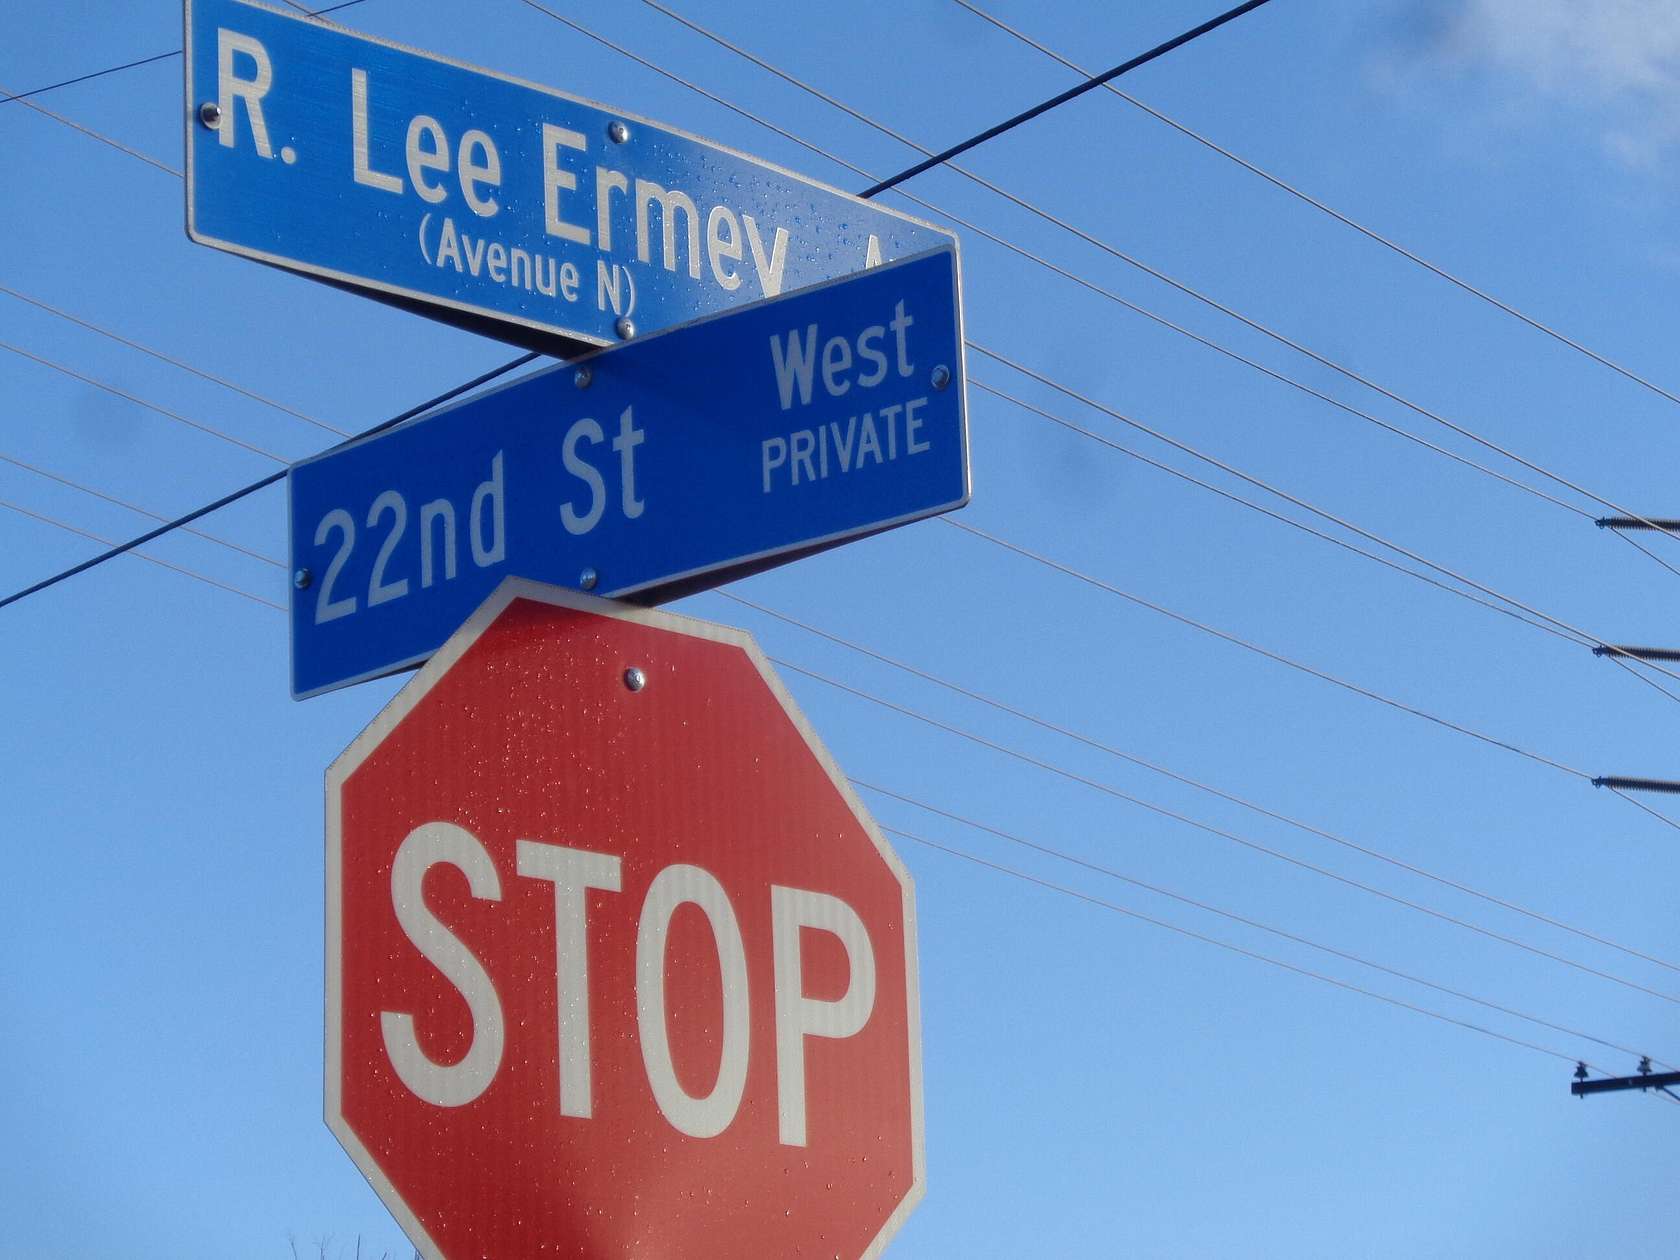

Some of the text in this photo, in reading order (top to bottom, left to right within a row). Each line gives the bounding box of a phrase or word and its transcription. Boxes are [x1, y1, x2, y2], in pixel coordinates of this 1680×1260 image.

[217, 26, 790, 299] R. Lee Ermey
[418, 211, 638, 318] (Avenue N)
[769, 298, 915, 411] West
[313, 404, 646, 626] 22nd St
[760, 398, 931, 494] PRIVATE
[379, 820, 877, 1148] STOP
